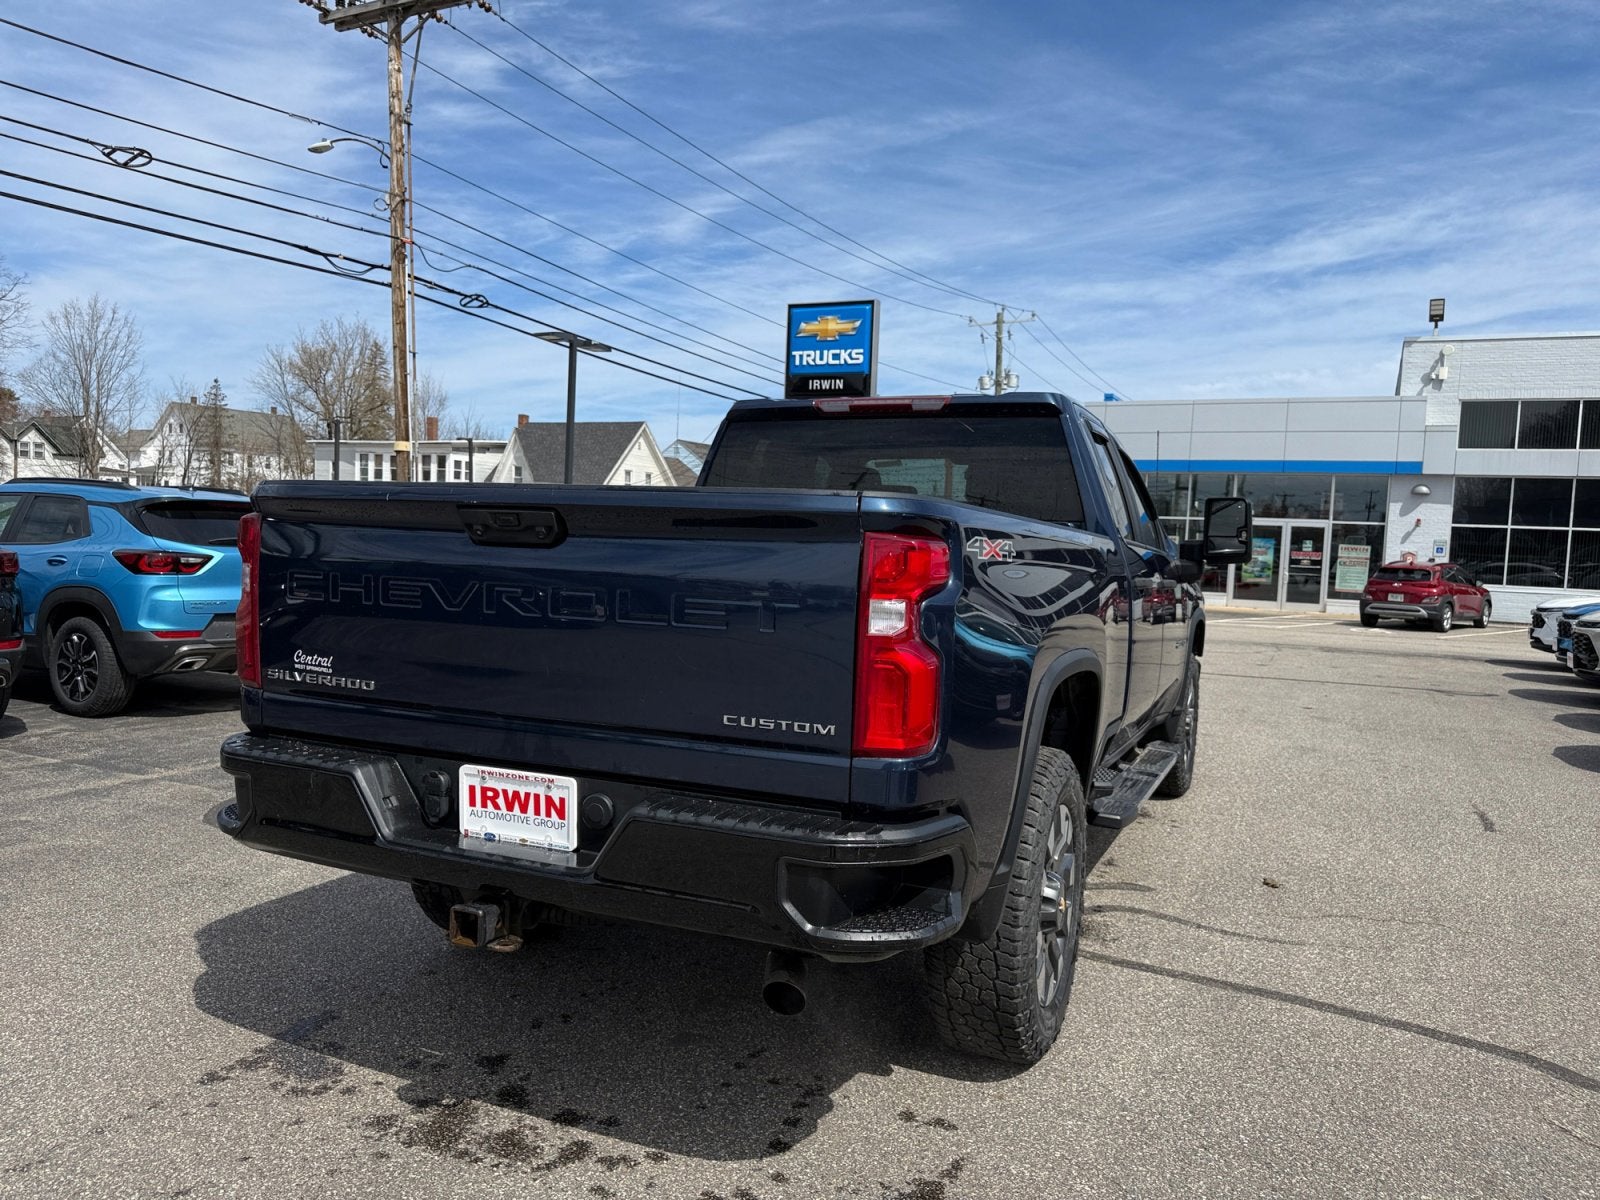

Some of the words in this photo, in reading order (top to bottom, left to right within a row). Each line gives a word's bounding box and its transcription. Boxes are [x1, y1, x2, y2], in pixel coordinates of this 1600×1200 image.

[791, 348, 864, 366] TRUCKS
[808, 378, 844, 390] IRWIN
[284, 569, 801, 633] CHEVROLET
[293, 649, 334, 667] Central
[306, 665, 333, 673] SPRINGFIELD
[267, 668, 375, 691] SILVERADO
[723, 714, 836, 736] CUSTOM
[477, 769, 555, 783] IRWINZONE.COM
[468, 784, 566, 821] IRWIN
[469, 808, 531, 825] AUTOMOTIVE
[533, 817, 566, 831] GROUP
